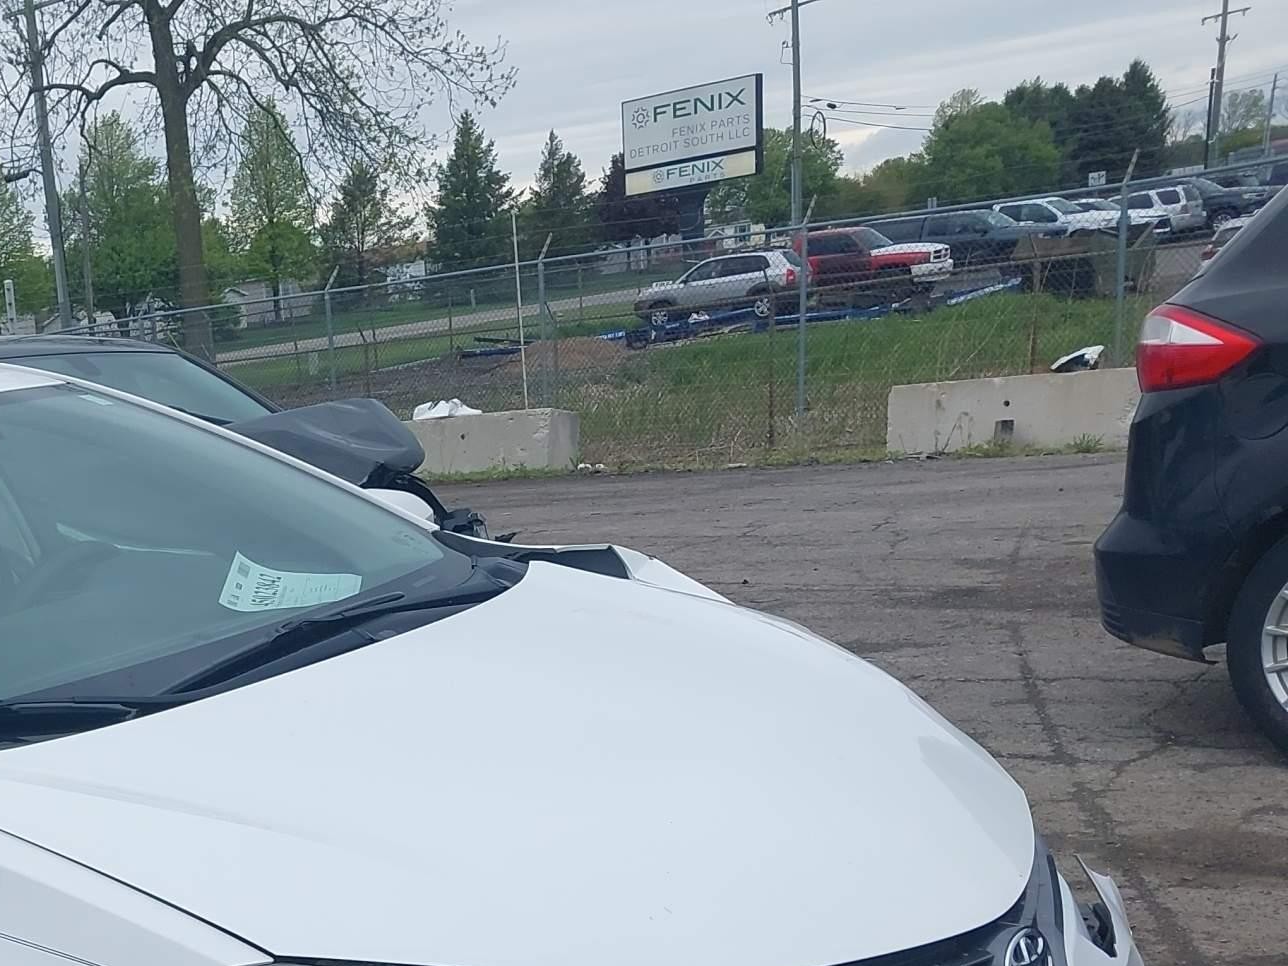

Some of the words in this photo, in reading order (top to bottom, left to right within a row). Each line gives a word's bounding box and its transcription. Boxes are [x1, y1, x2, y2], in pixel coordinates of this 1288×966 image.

[653, 87, 746, 123] FENIX
[672, 122, 706, 138] FENIX
[711, 113, 751, 128] PARTS
[629, 140, 680, 159] DETROIT
[683, 131, 724, 149] SOUTH
[728, 126, 751, 140] LLC
[666, 158, 725, 180] FENIX
